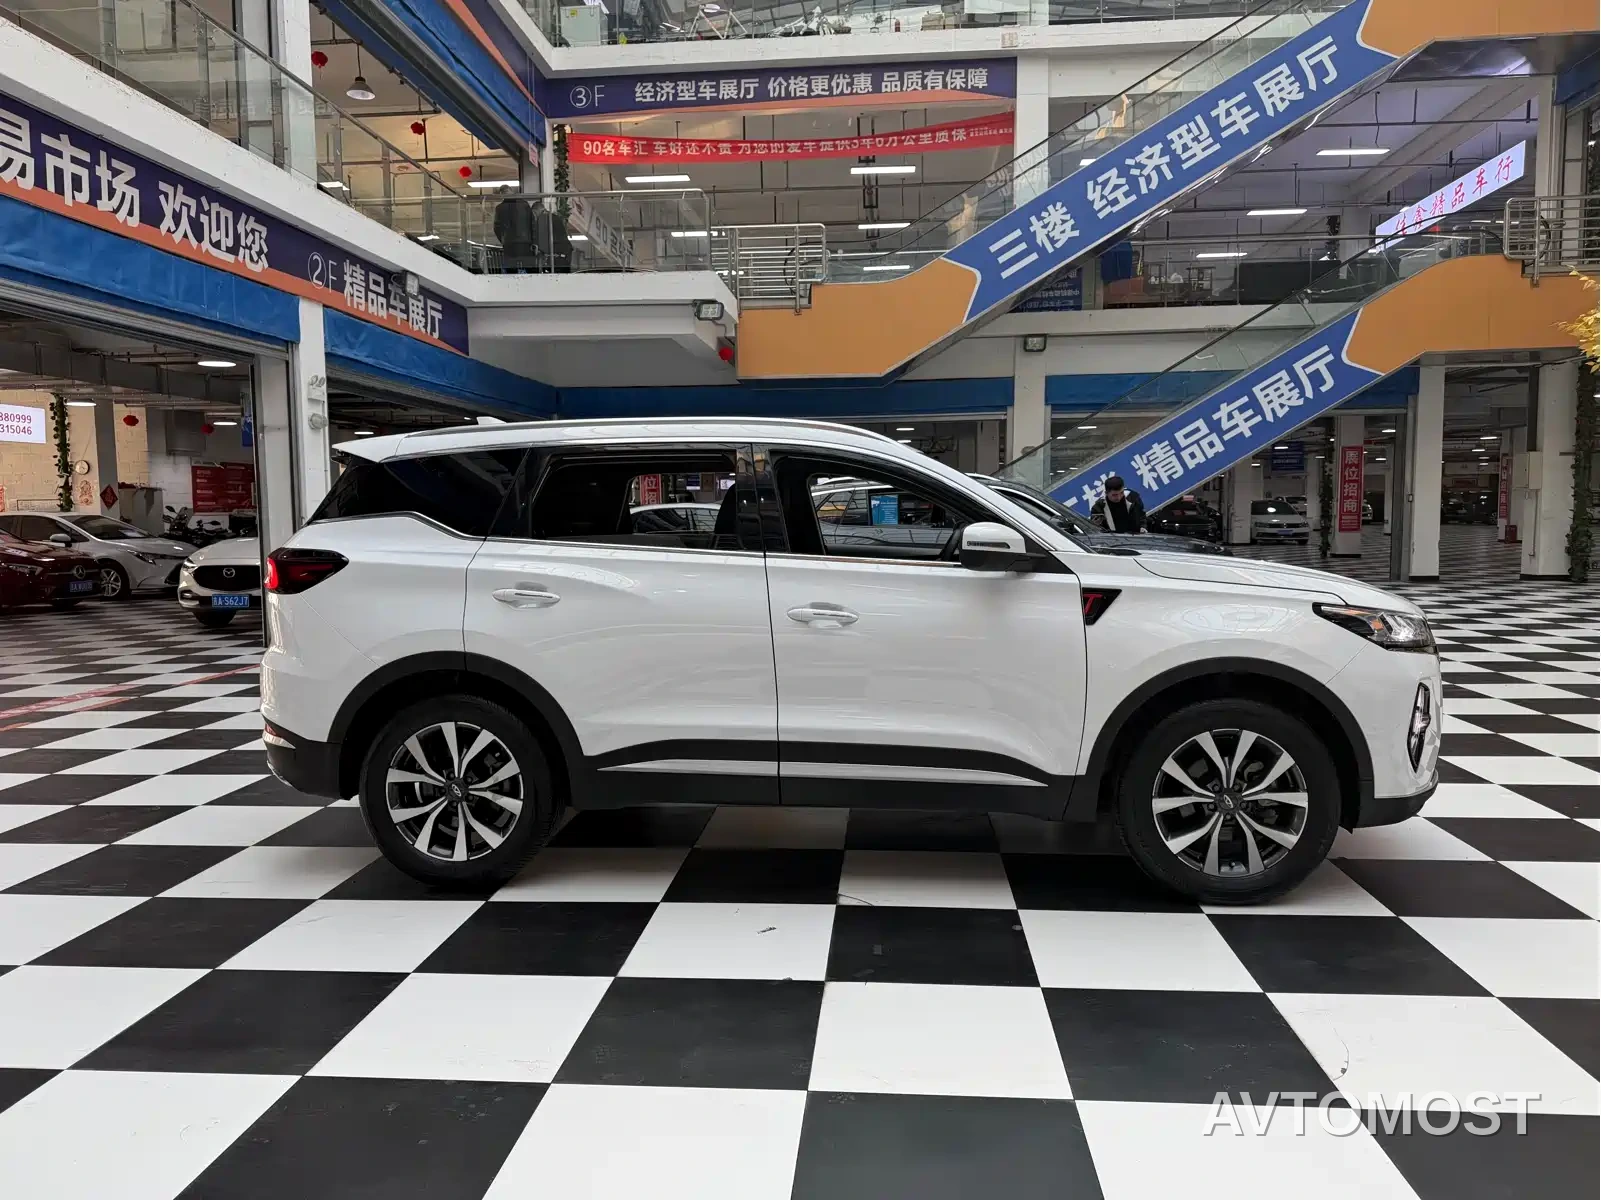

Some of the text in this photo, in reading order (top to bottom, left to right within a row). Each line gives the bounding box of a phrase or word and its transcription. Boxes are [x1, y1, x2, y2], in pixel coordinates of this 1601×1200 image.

[634, 68, 988, 103] 经济型车展厅 价格更优惠 品质有保障
[583, 140, 648, 157] 90名车汇
[988, 36, 1340, 280] 三楼 经济型车展厅
[0, 109, 269, 273] 易市场 欢迎您
[343, 259, 443, 340] 精品车展厅
[1131, 344, 1336, 492] 精品车展厅
[1343, 451, 1359, 513] 展位招商
